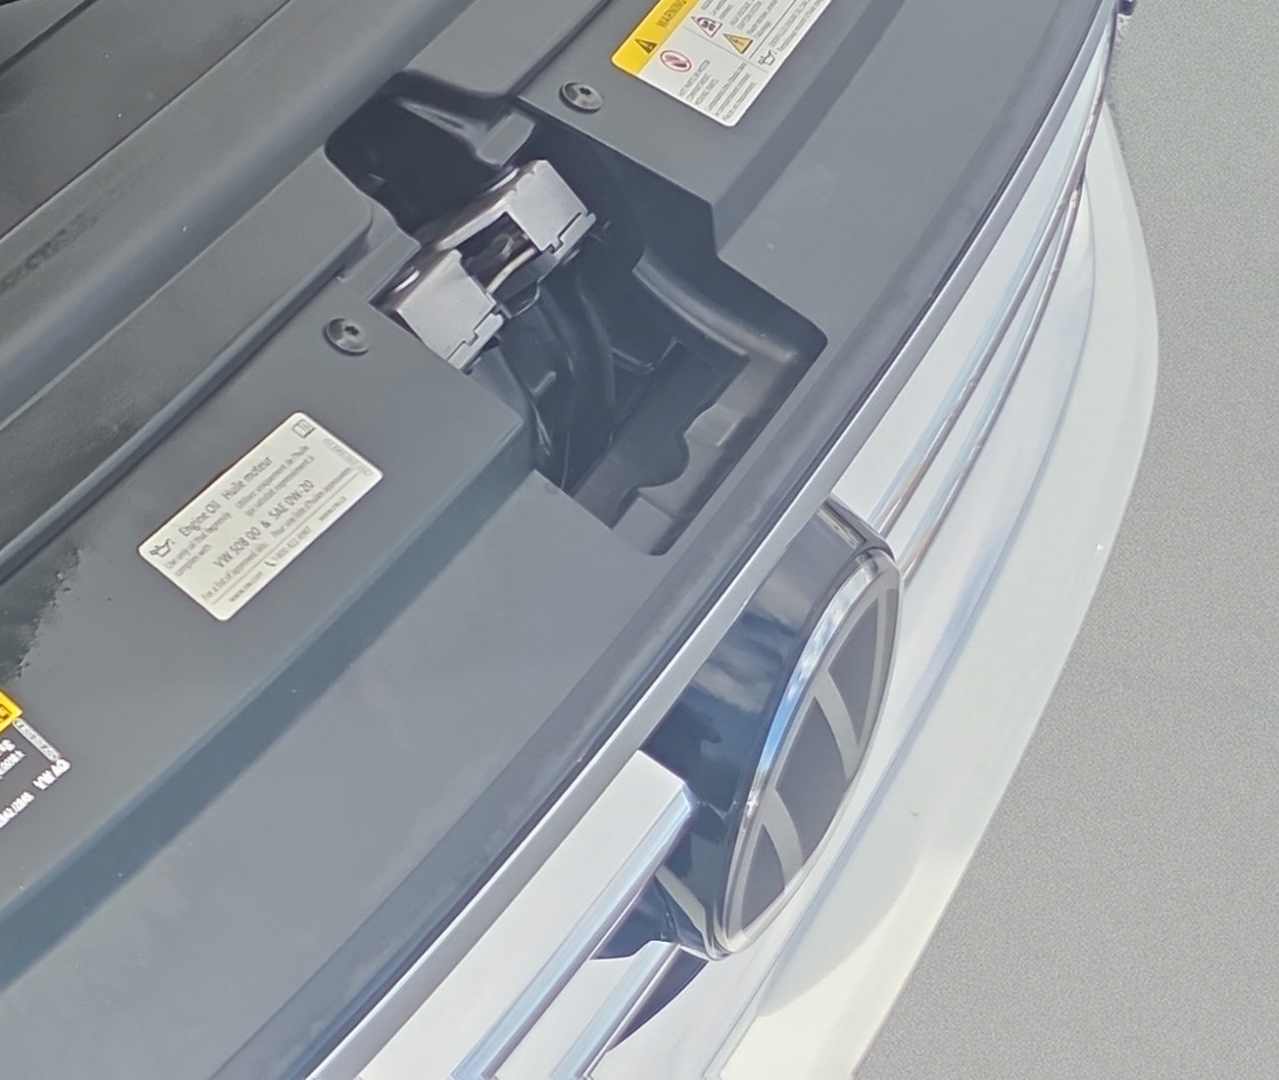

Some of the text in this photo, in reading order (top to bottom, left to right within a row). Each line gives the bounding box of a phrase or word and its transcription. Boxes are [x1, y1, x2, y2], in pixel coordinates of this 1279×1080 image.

[179, 456, 272, 538] Engine Oil Huile moteur
[213, 551, 233, 568] VW
[229, 537, 248, 554] 508
[268, 503, 288, 519] SAE
[284, 479, 314, 505] 0W-20
